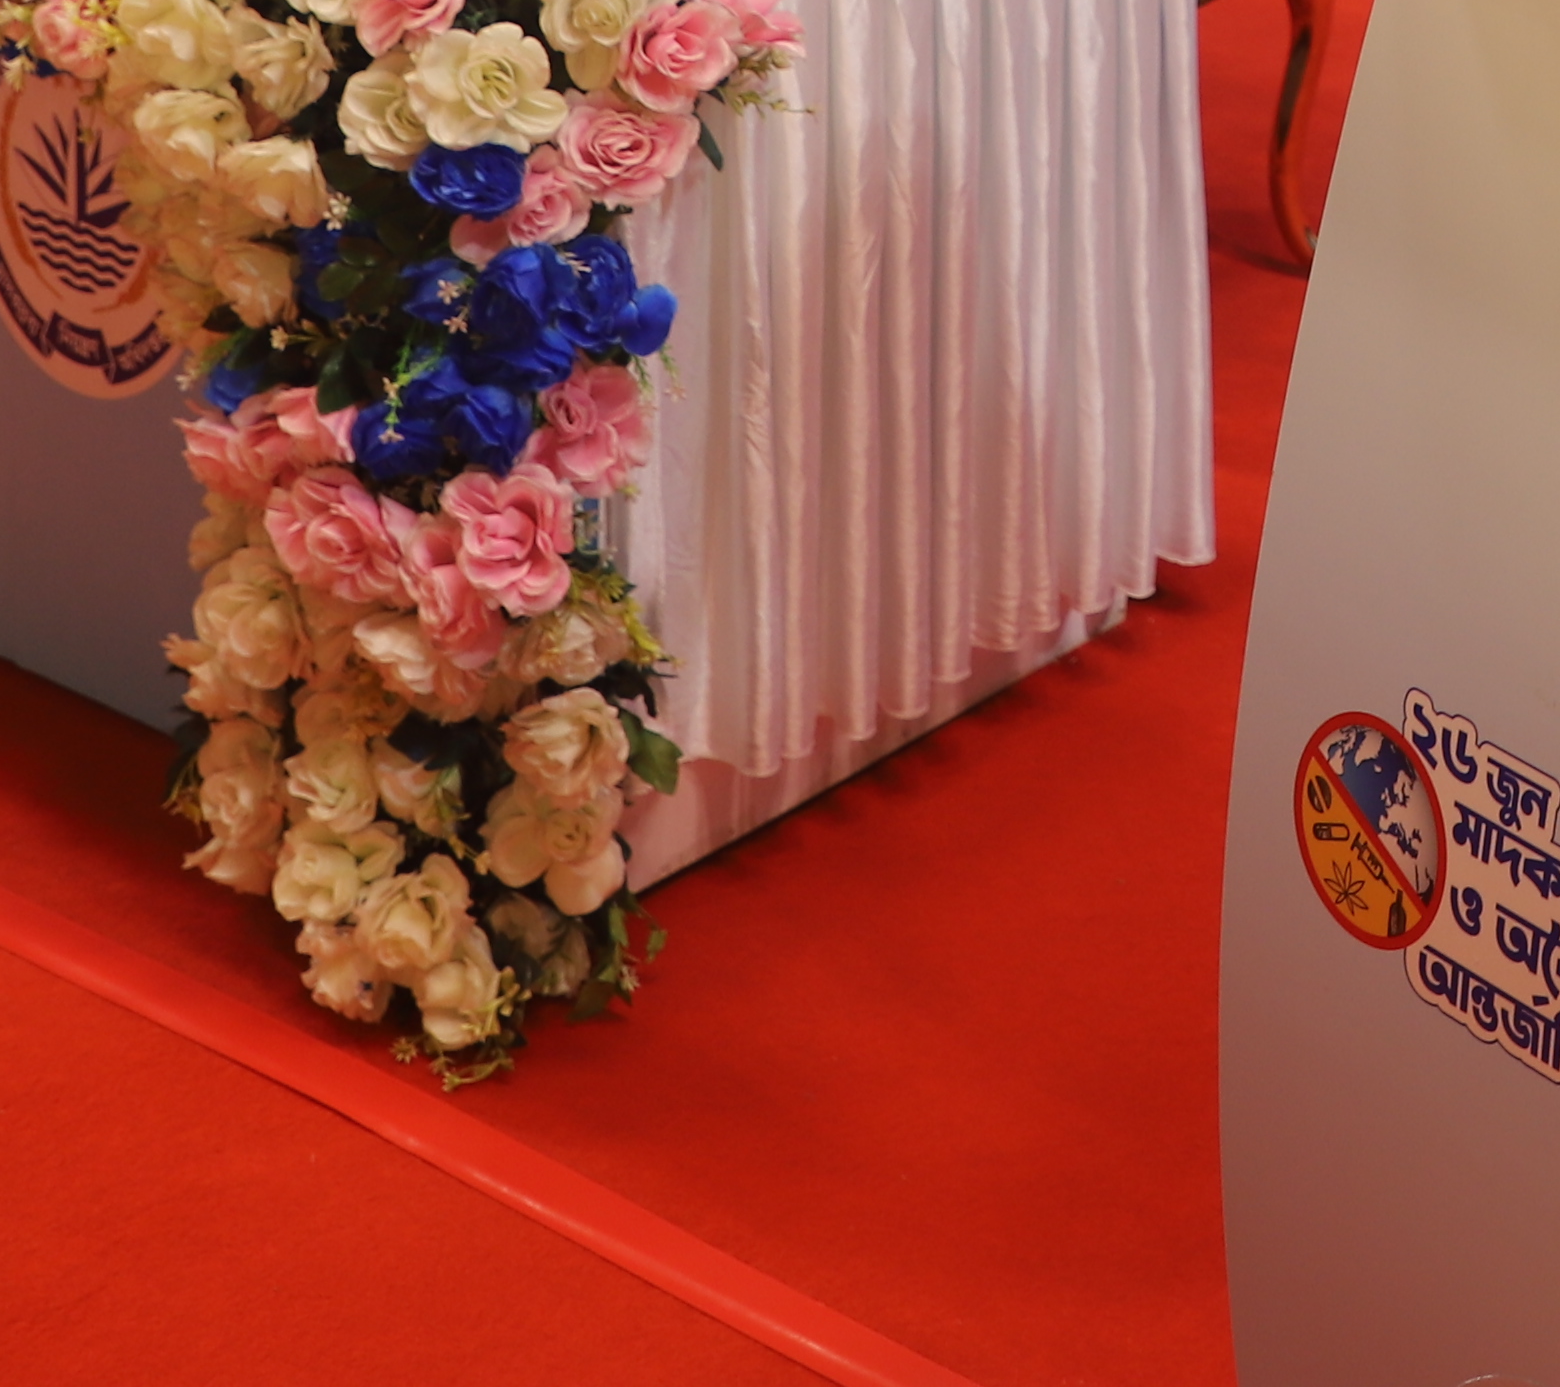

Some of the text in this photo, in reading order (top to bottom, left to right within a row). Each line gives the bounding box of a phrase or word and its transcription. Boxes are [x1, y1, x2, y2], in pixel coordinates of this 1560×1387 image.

[1411, 703, 1552, 834] ২৬ জুন
[1451, 885, 1483, 936] ও
